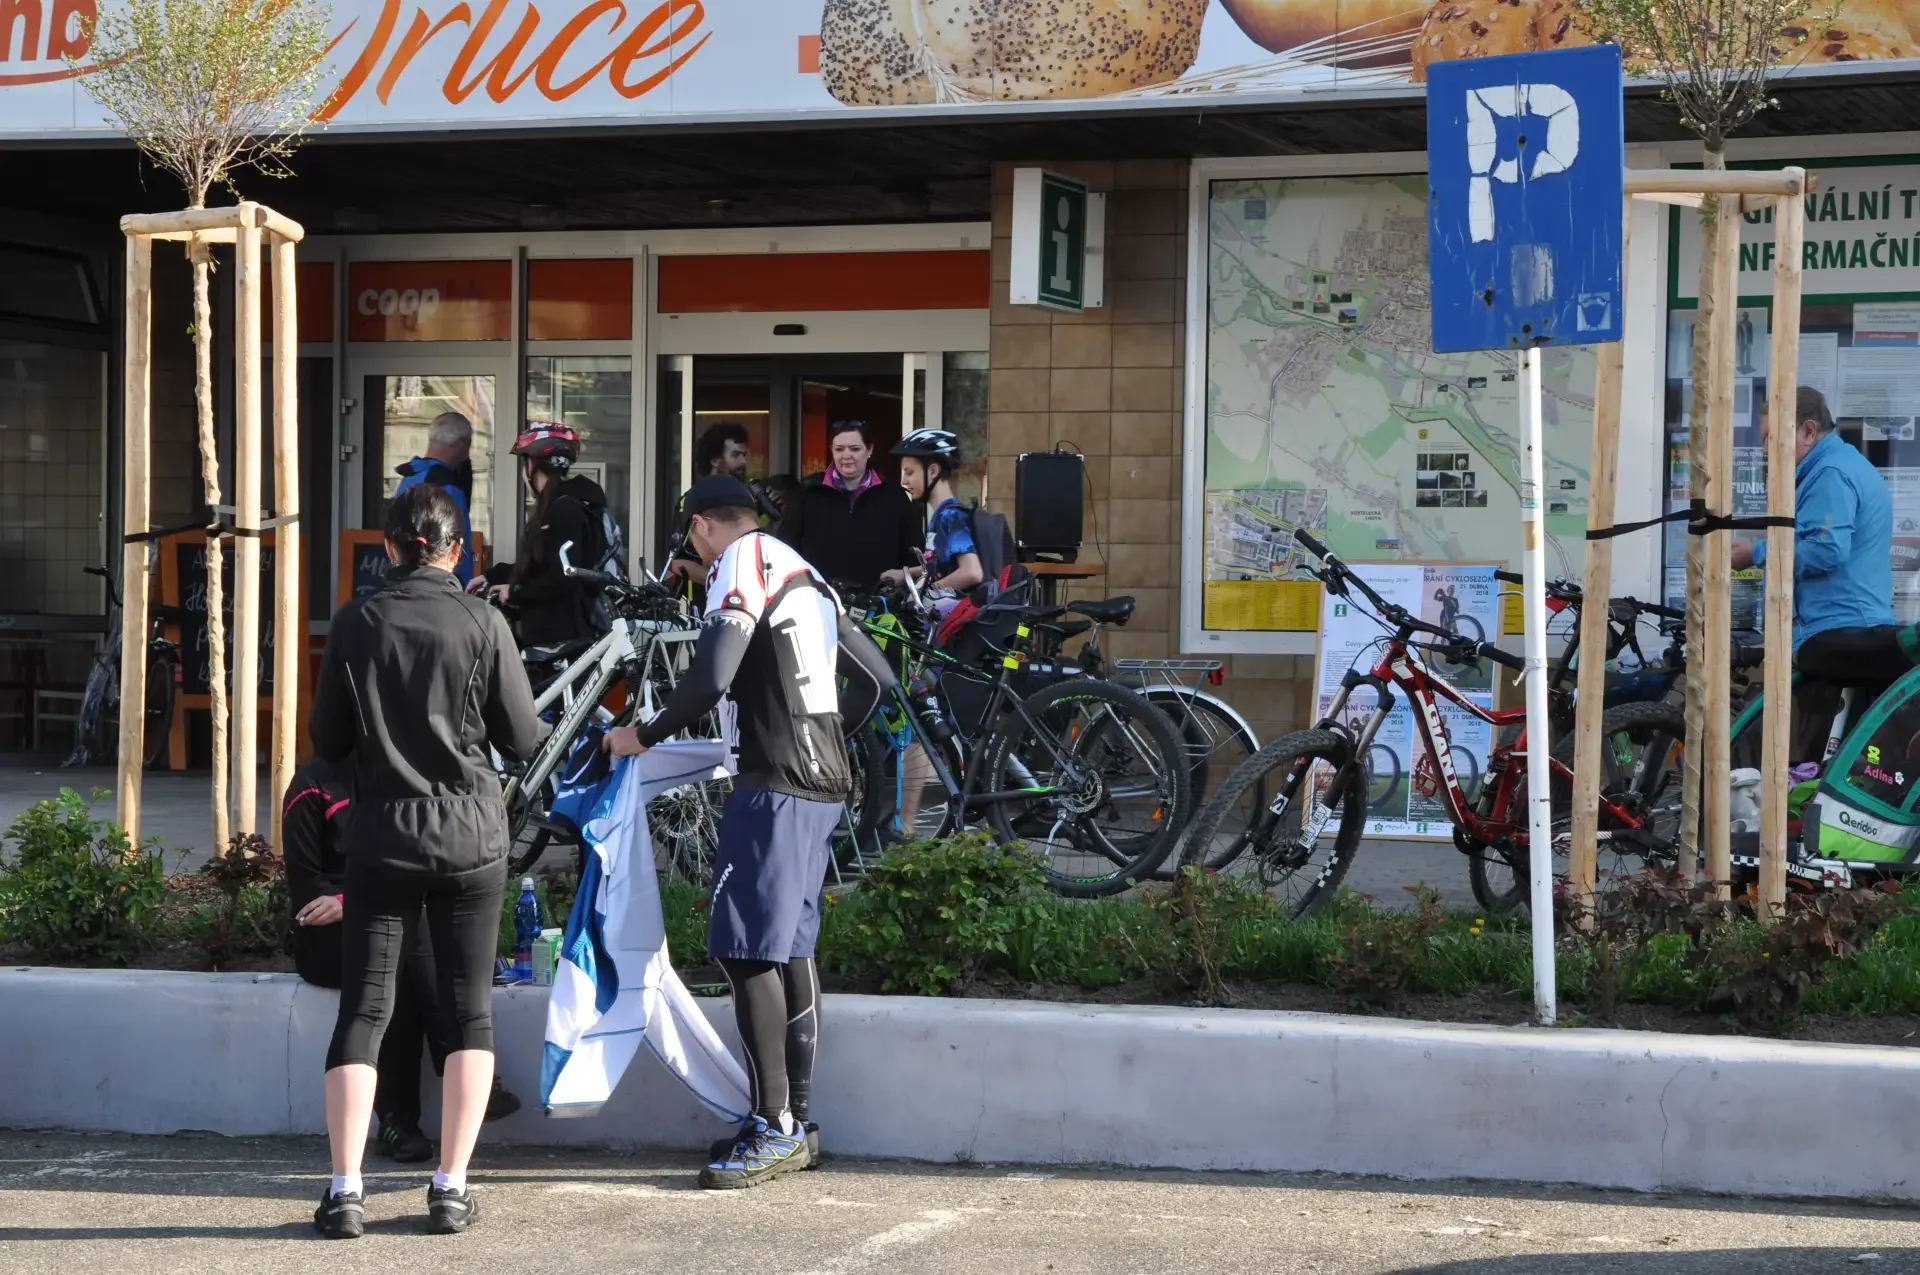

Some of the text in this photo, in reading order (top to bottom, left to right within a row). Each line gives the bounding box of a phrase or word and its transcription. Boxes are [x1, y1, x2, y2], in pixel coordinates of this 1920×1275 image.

[1466, 83, 1580, 243] P
[1900, 189, 1920, 218] T
[1740, 231, 1920, 271] NFRMAČNÍ
[358, 288, 440, 324] coop
[1864, 765, 1893, 785] Adina
[1839, 811, 1878, 836] Qeridoo
